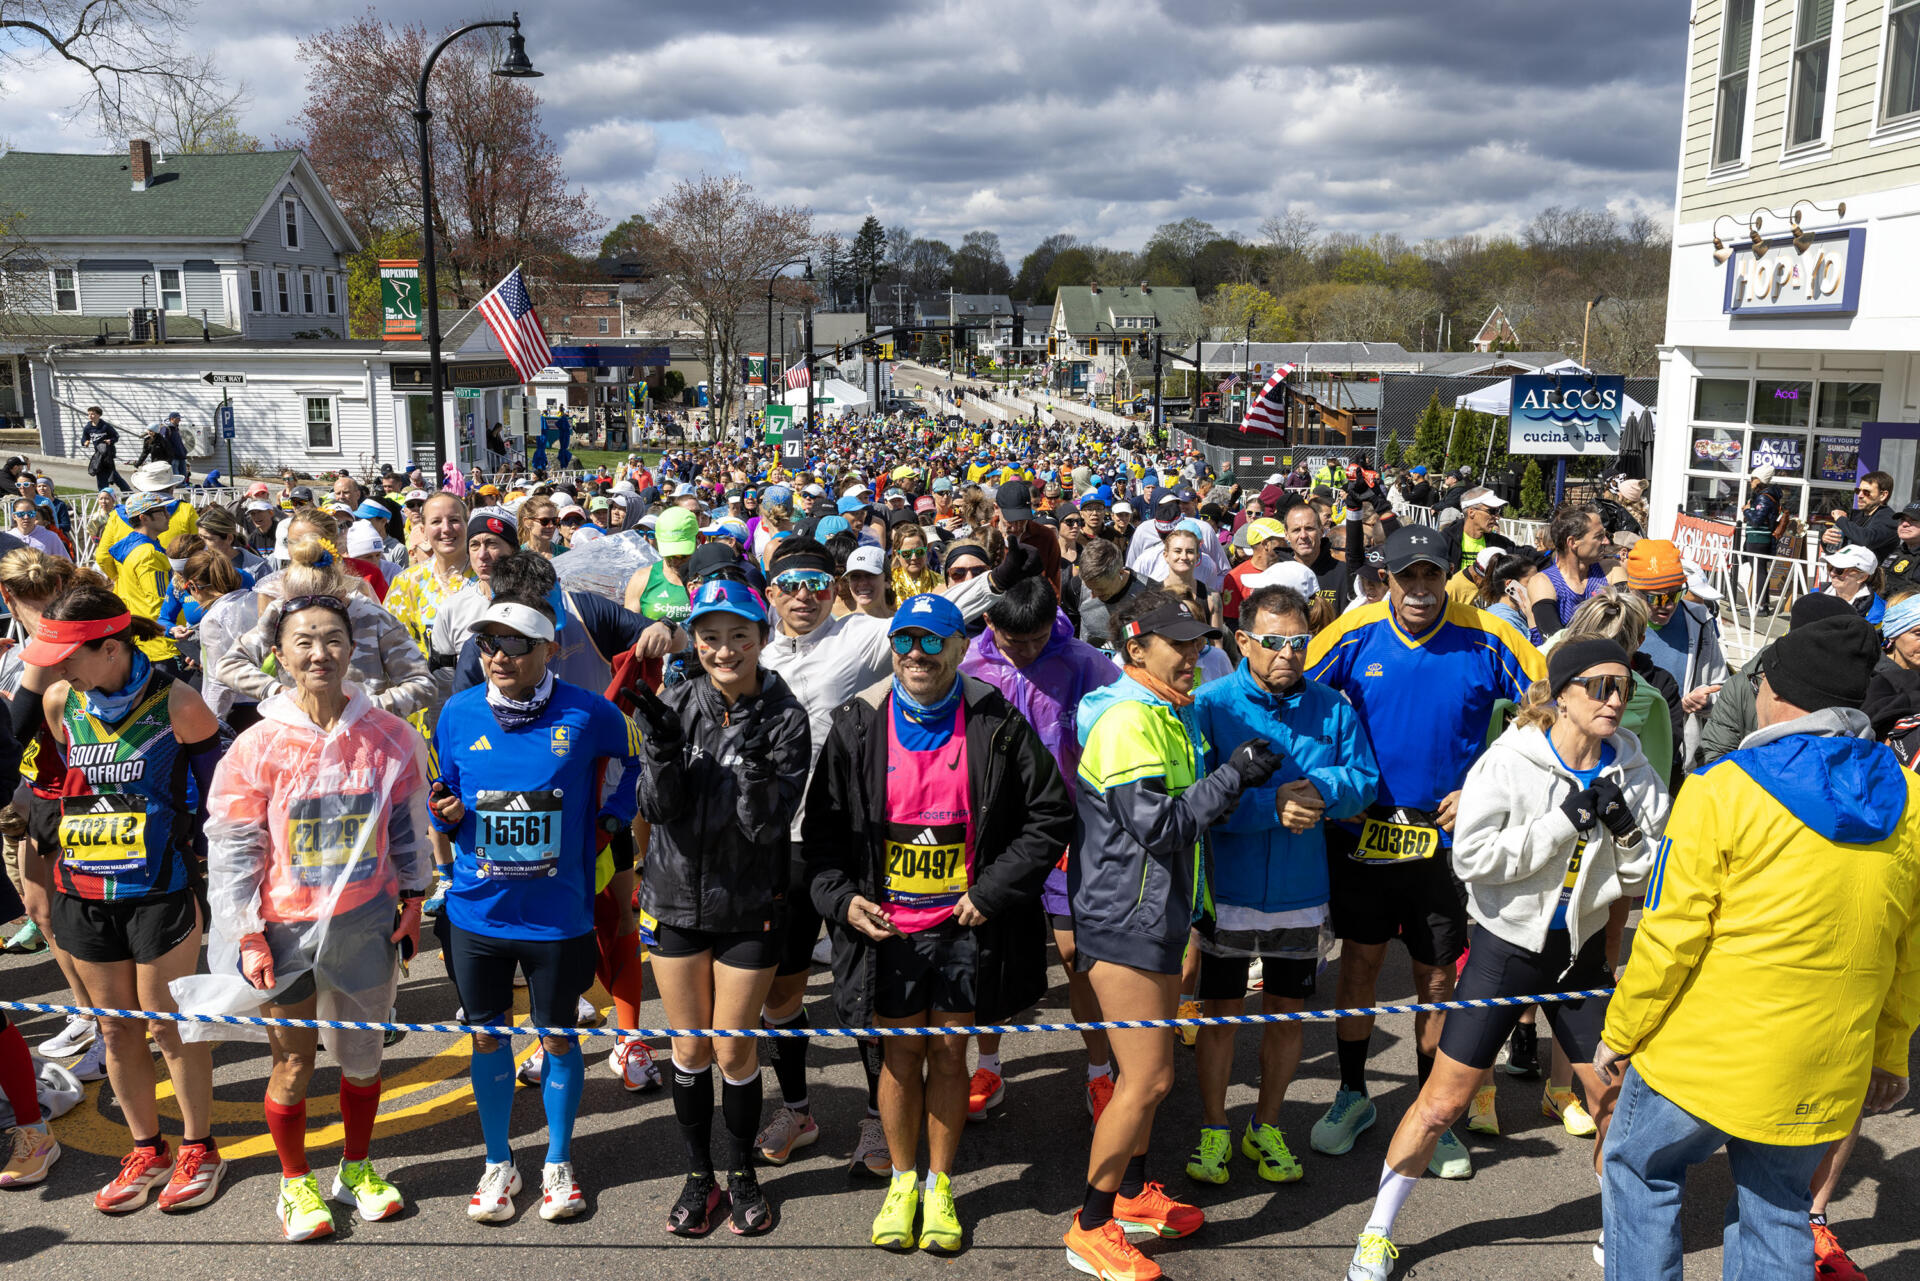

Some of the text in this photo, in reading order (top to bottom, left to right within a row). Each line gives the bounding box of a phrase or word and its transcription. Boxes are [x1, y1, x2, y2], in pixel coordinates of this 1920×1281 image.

[381, 269, 418, 278] HOPKINTON
[456, 387, 471, 397] HOYT
[1520, 388, 1617, 410] ARCOS
[1774, 388, 1798, 400] Acai
[224, 411, 231, 425] P
[773, 417, 785, 432] 7
[1523, 430, 1569, 442] cucina
[1585, 430, 1608, 442] bar
[787, 442, 797, 456] 7
[1760, 439, 1797, 454] ACAI
[1752, 452, 1801, 468] BOWLS
[69, 742, 118, 767] SOUTH
[87, 760, 145, 784] AFRICA
[66, 816, 138, 847] 20213
[482, 814, 551, 846] 15561
[1365, 823, 1431, 855] 20360
[65, 848, 74, 858] 7
[476, 848, 484, 856] 8
[524, 864, 551, 872] MARATHON
[888, 844, 960, 880] 20497
